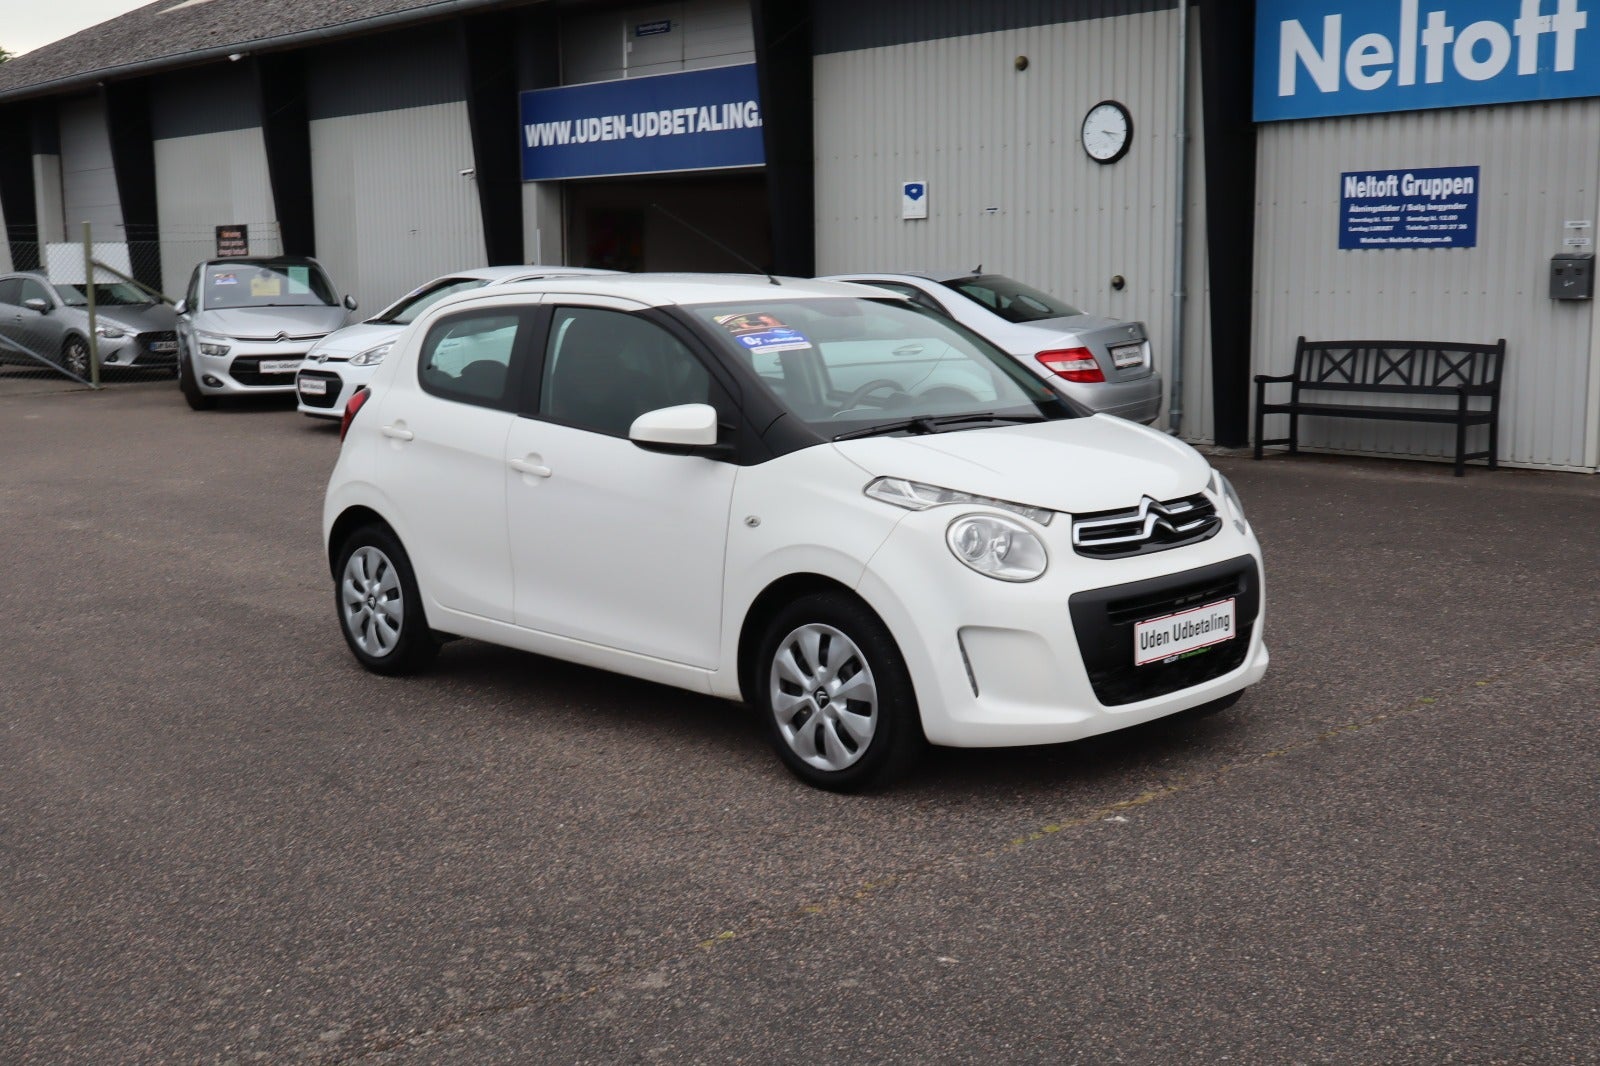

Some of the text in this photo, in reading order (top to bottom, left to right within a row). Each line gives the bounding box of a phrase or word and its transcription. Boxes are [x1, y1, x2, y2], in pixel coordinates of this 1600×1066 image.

[1278, 0, 1588, 97] Neltoft
[524, 100, 763, 148] WWW.UDEN-UDBETALING.
[1344, 173, 1474, 200] Neltoft Gruppen
[1140, 613, 1230, 650] Uden Udbetaling
